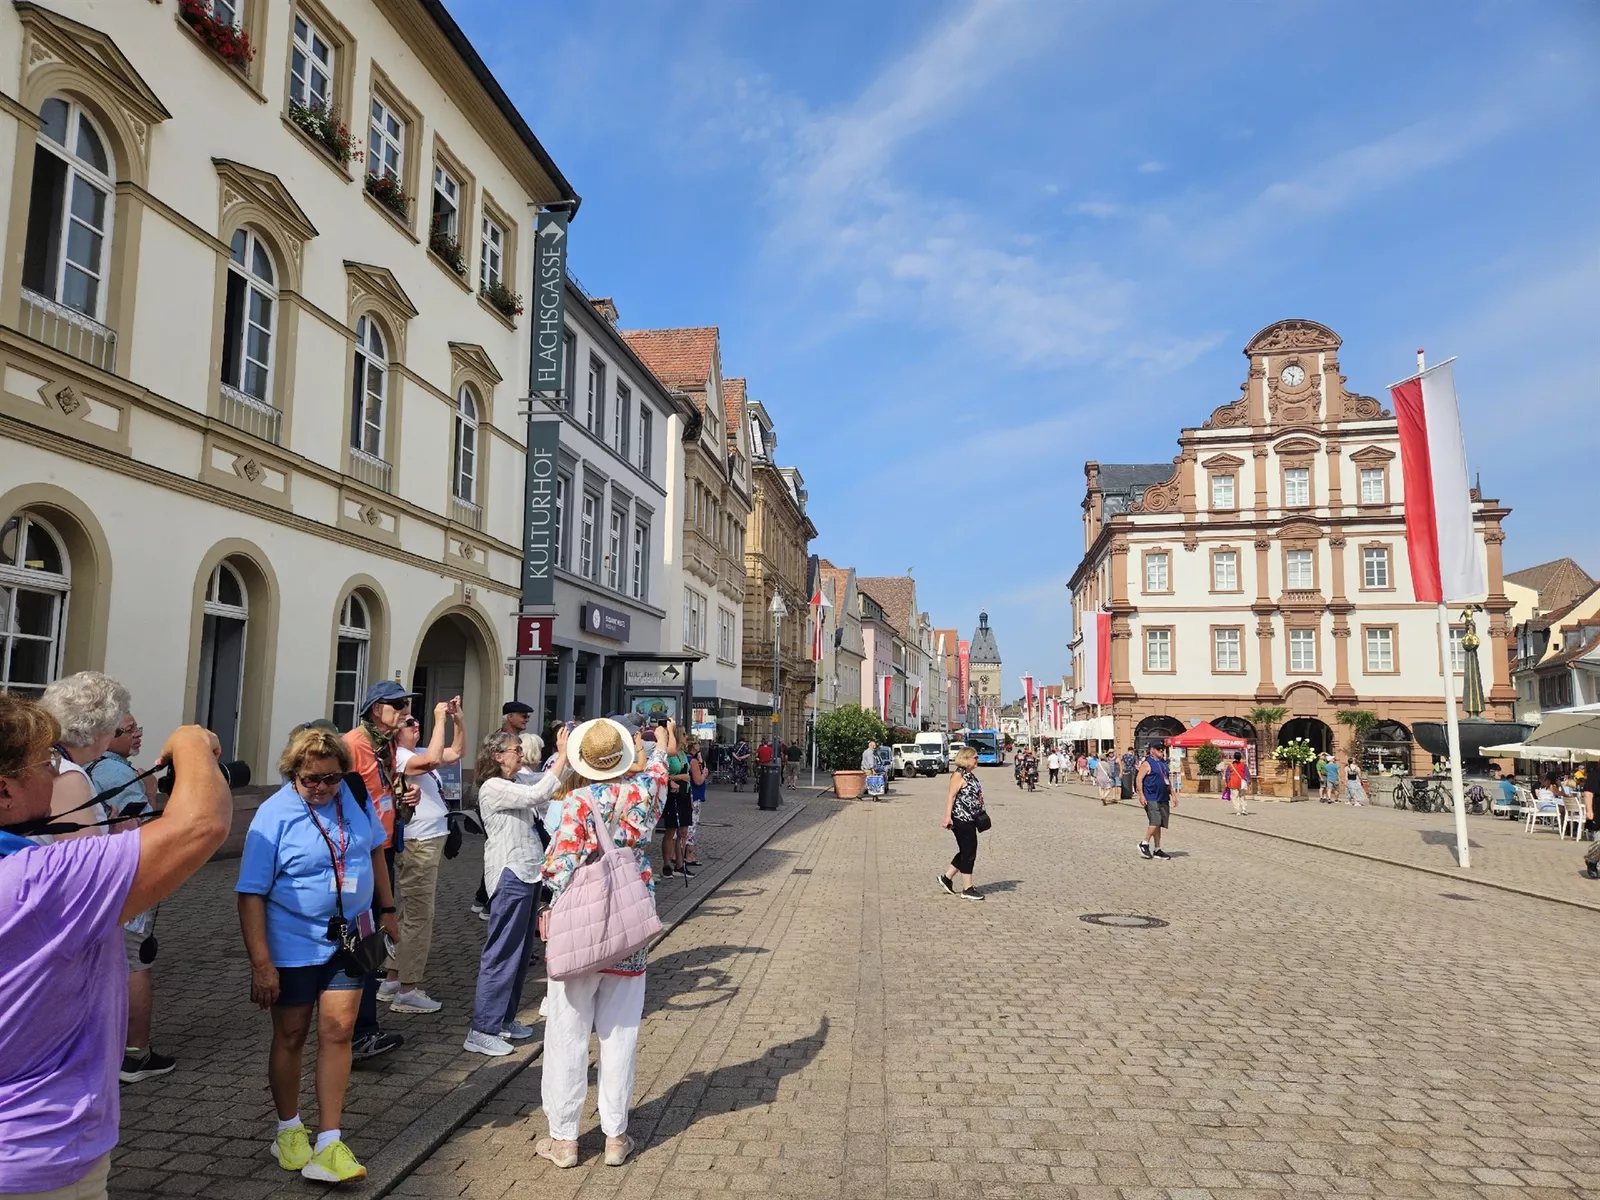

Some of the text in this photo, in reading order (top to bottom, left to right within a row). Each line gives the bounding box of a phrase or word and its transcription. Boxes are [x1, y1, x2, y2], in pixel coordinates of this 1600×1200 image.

[538, 247, 561, 382] FLACHSGASSE
[529, 447, 553, 579] KULTURHOF
[528, 621, 543, 652] i
